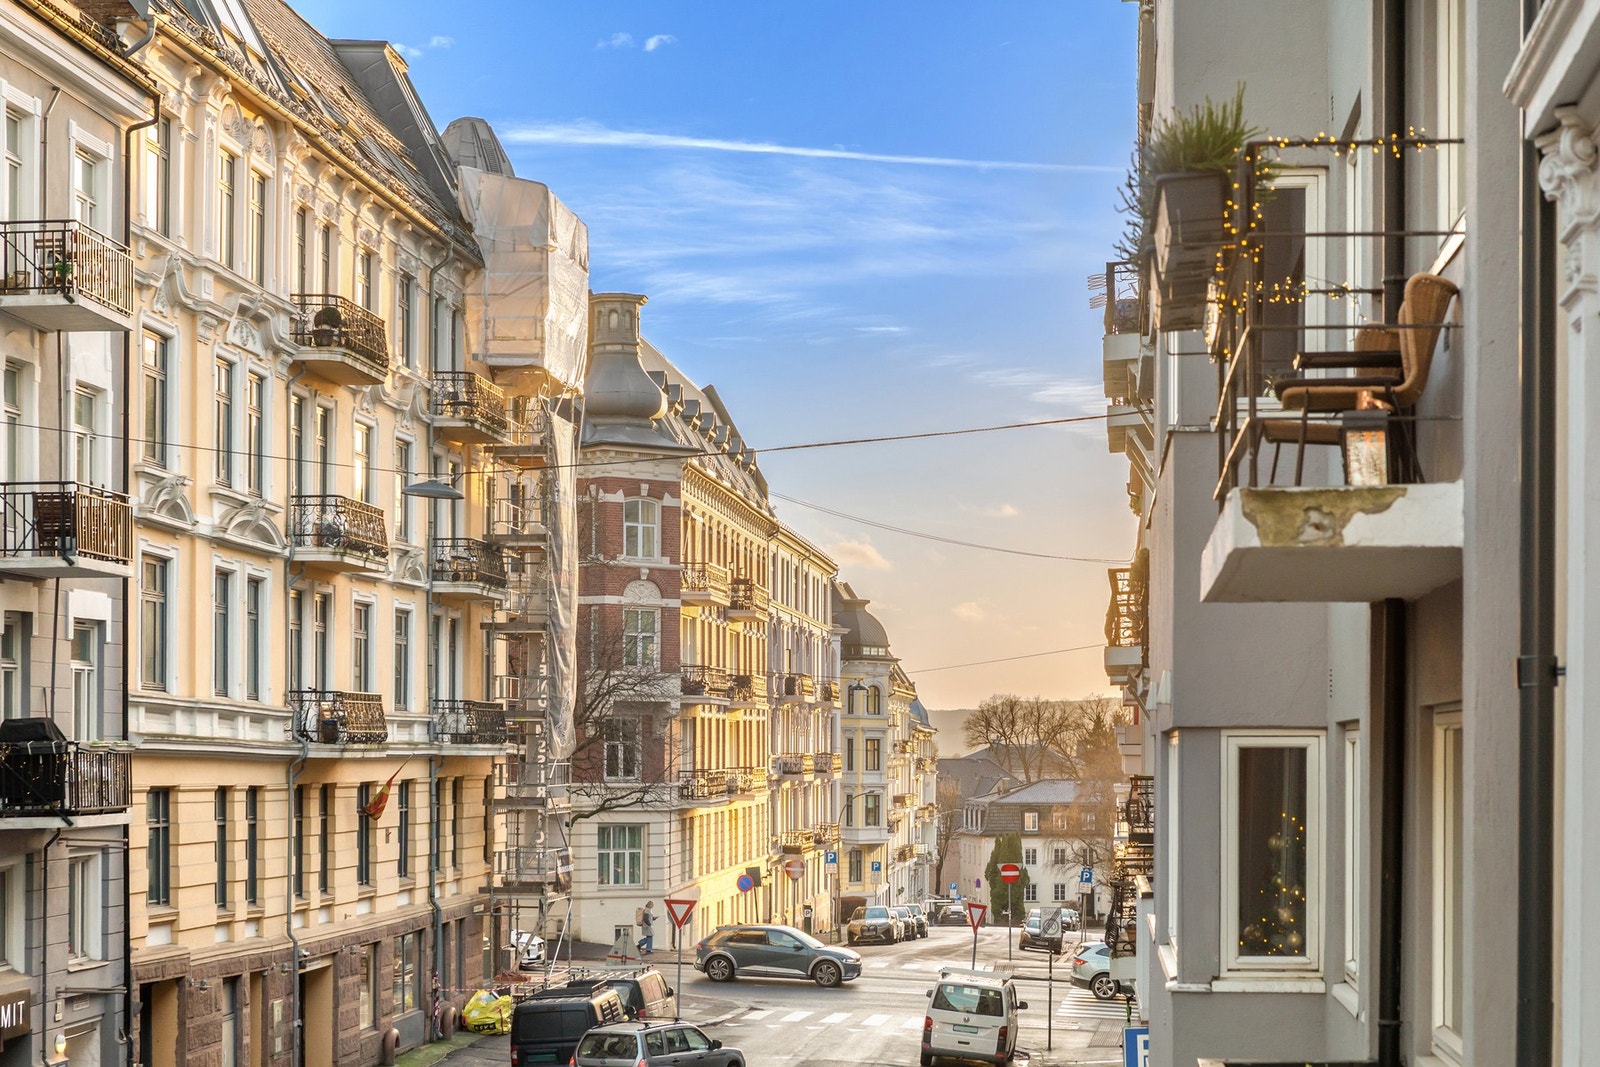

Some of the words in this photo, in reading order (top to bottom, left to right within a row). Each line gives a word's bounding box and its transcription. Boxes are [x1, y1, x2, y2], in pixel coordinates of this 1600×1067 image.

[827, 852, 835, 863] P
[1082, 872, 1090, 882] P
[1, 1000, 25, 1029] MIT
